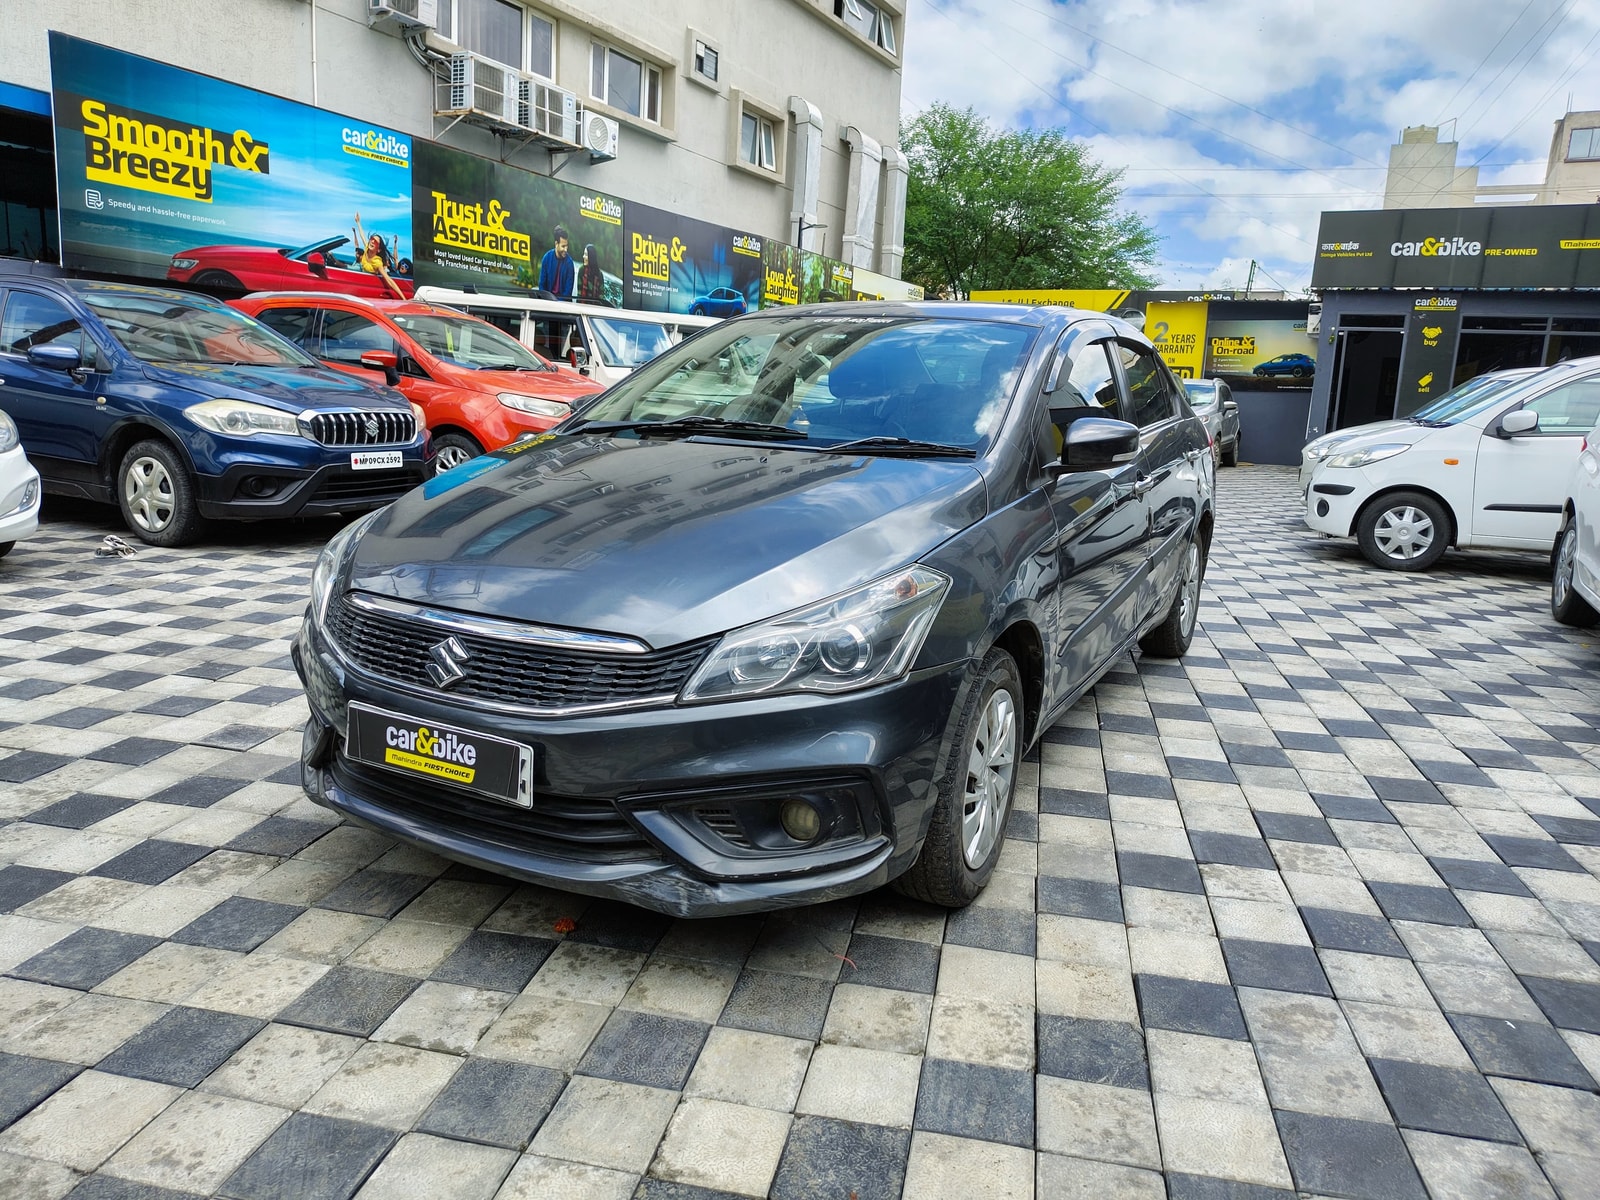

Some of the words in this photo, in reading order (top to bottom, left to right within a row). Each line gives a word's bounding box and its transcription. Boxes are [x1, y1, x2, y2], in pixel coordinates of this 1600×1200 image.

[81, 99, 226, 166] Smooth
[229, 129, 270, 174] &
[342, 127, 409, 159] car&bike
[86, 136, 212, 200] Breezy
[370, 153, 386, 161] FIRST
[386, 157, 404, 166] CHOICE
[108, 199, 136, 213] Speedy
[137, 204, 151, 213] and
[152, 206, 191, 221] hassle-free
[192, 214, 226, 226] paperwork
[432, 191, 483, 226] Trust
[487, 199, 511, 231] &
[580, 195, 622, 218] car&bike
[433, 217, 529, 257] Assurance
[632, 232, 669, 258] Drive
[670, 236, 687, 263] &
[733, 236, 761, 252] car&bike
[1390, 237, 1482, 257] car&bike
[1484, 248, 1538, 256] PRE-OWNED
[434, 249, 447, 258] Most
[447, 251, 461, 261] loved
[461, 254, 474, 263] Used
[474, 257, 483, 265] Car
[482, 258, 497, 268] brand
[502, 262, 514, 271] India
[437, 258, 445, 267] By
[445, 260, 469, 271] Franchise
[632, 254, 668, 278] Smile
[766, 265, 785, 283] Love
[785, 268, 796, 287] &
[765, 280, 798, 300] Laughter
[1415, 296, 1458, 307] car&bike
[1153, 321, 1169, 343] 2
[1171, 334, 1197, 344] YEARS
[1212, 337, 1240, 346] Online
[1241, 335, 1255, 347] &
[1423, 339, 1438, 347] buy
[1216, 346, 1255, 355] On-road
[386, 725, 477, 766] car&bike
[423, 761, 444, 772] FIRST
[444, 767, 471, 779] CHOICE
